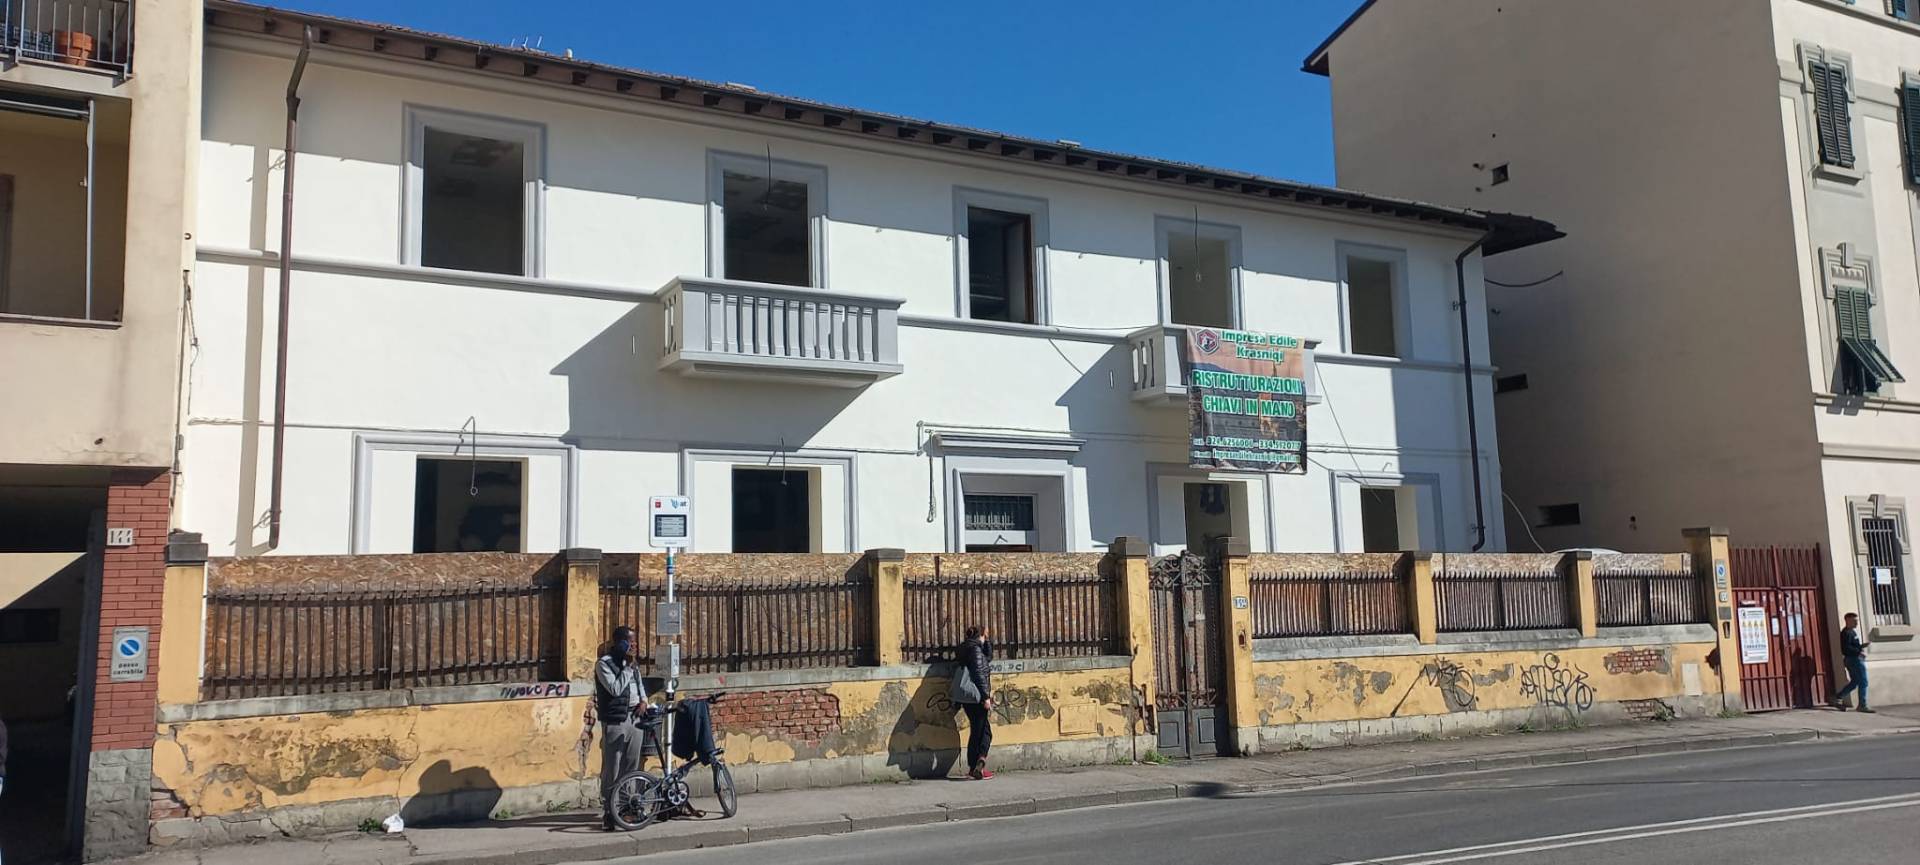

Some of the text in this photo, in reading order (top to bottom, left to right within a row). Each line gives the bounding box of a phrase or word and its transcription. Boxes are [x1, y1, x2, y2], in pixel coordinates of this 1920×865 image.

[1222, 331, 1297, 347] Impresa Edile
[1236, 346, 1284, 363] Krasniqi
[1193, 370, 1303, 394] RISTRUTTURAZIONI
[1203, 396, 1295, 417] CHIAVI IN MANO
[110, 530, 131, 544] 144
[501, 683, 570, 698] NUOVO PCI
